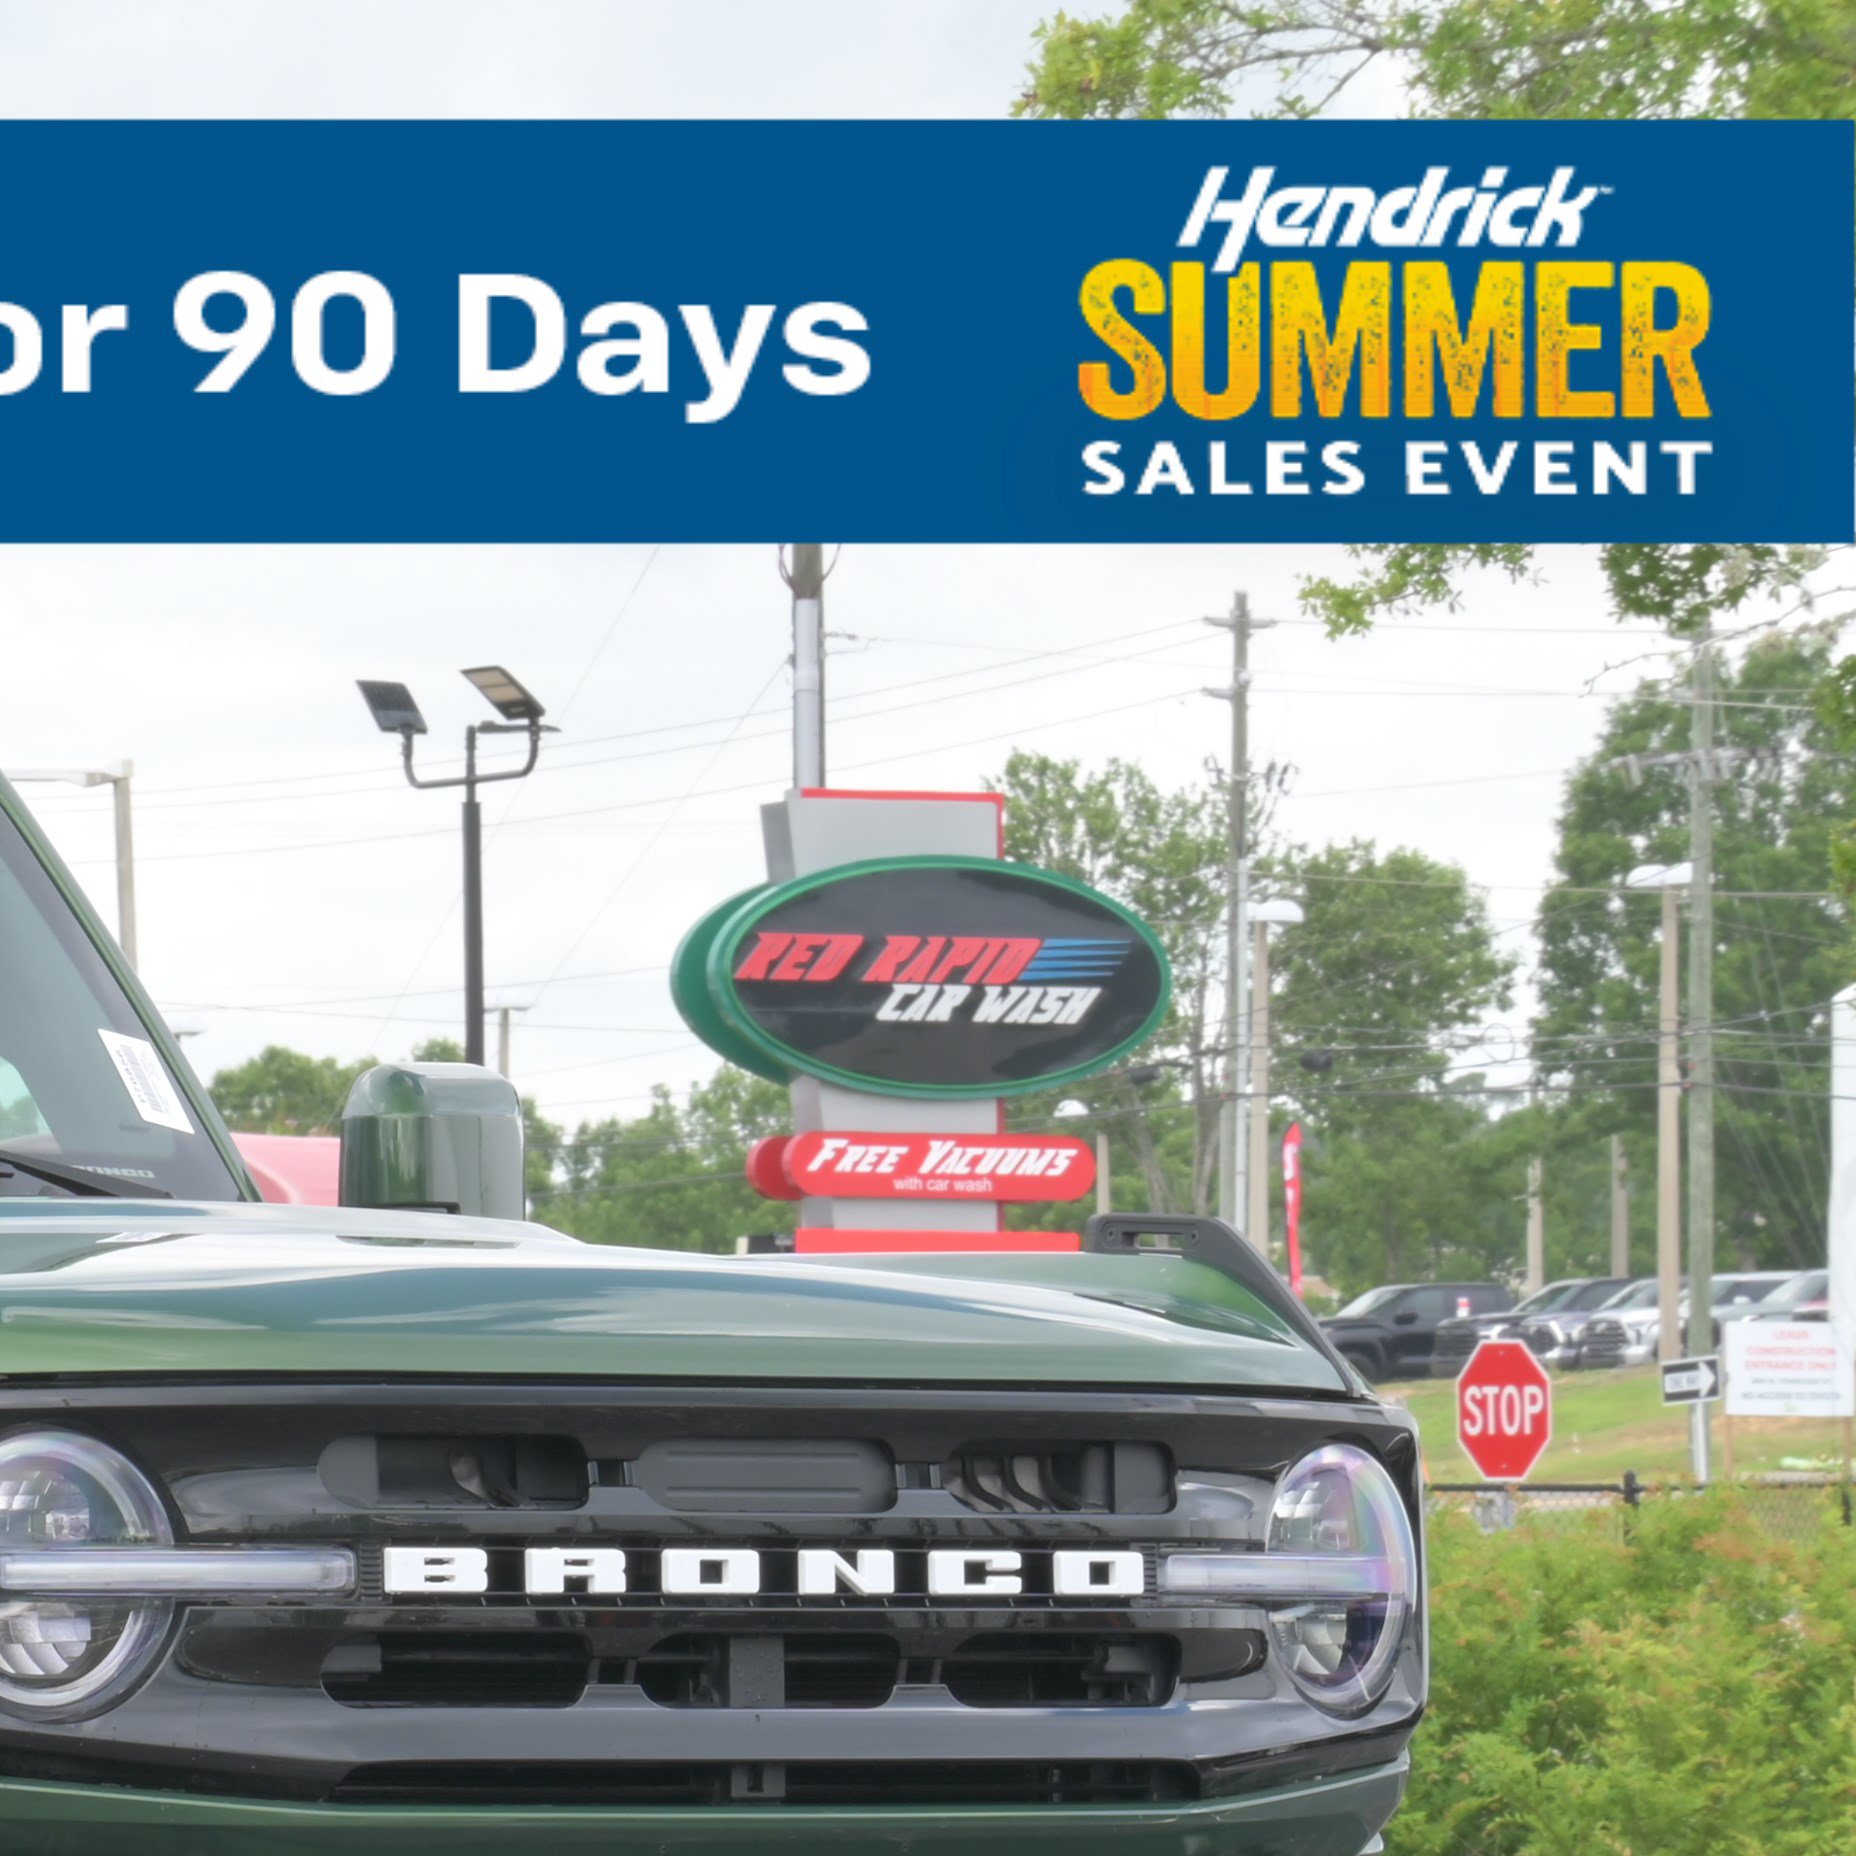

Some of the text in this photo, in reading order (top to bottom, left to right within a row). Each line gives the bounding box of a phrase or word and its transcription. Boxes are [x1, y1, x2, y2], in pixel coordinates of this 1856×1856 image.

[734, 932, 1042, 984] RED RAPID
[875, 983, 1102, 1024] CAR WASH
[894, 1177, 993, 1193] with car wash
[1463, 1384, 1545, 1437] STOP
[382, 1546, 1147, 1598] BRONCO
